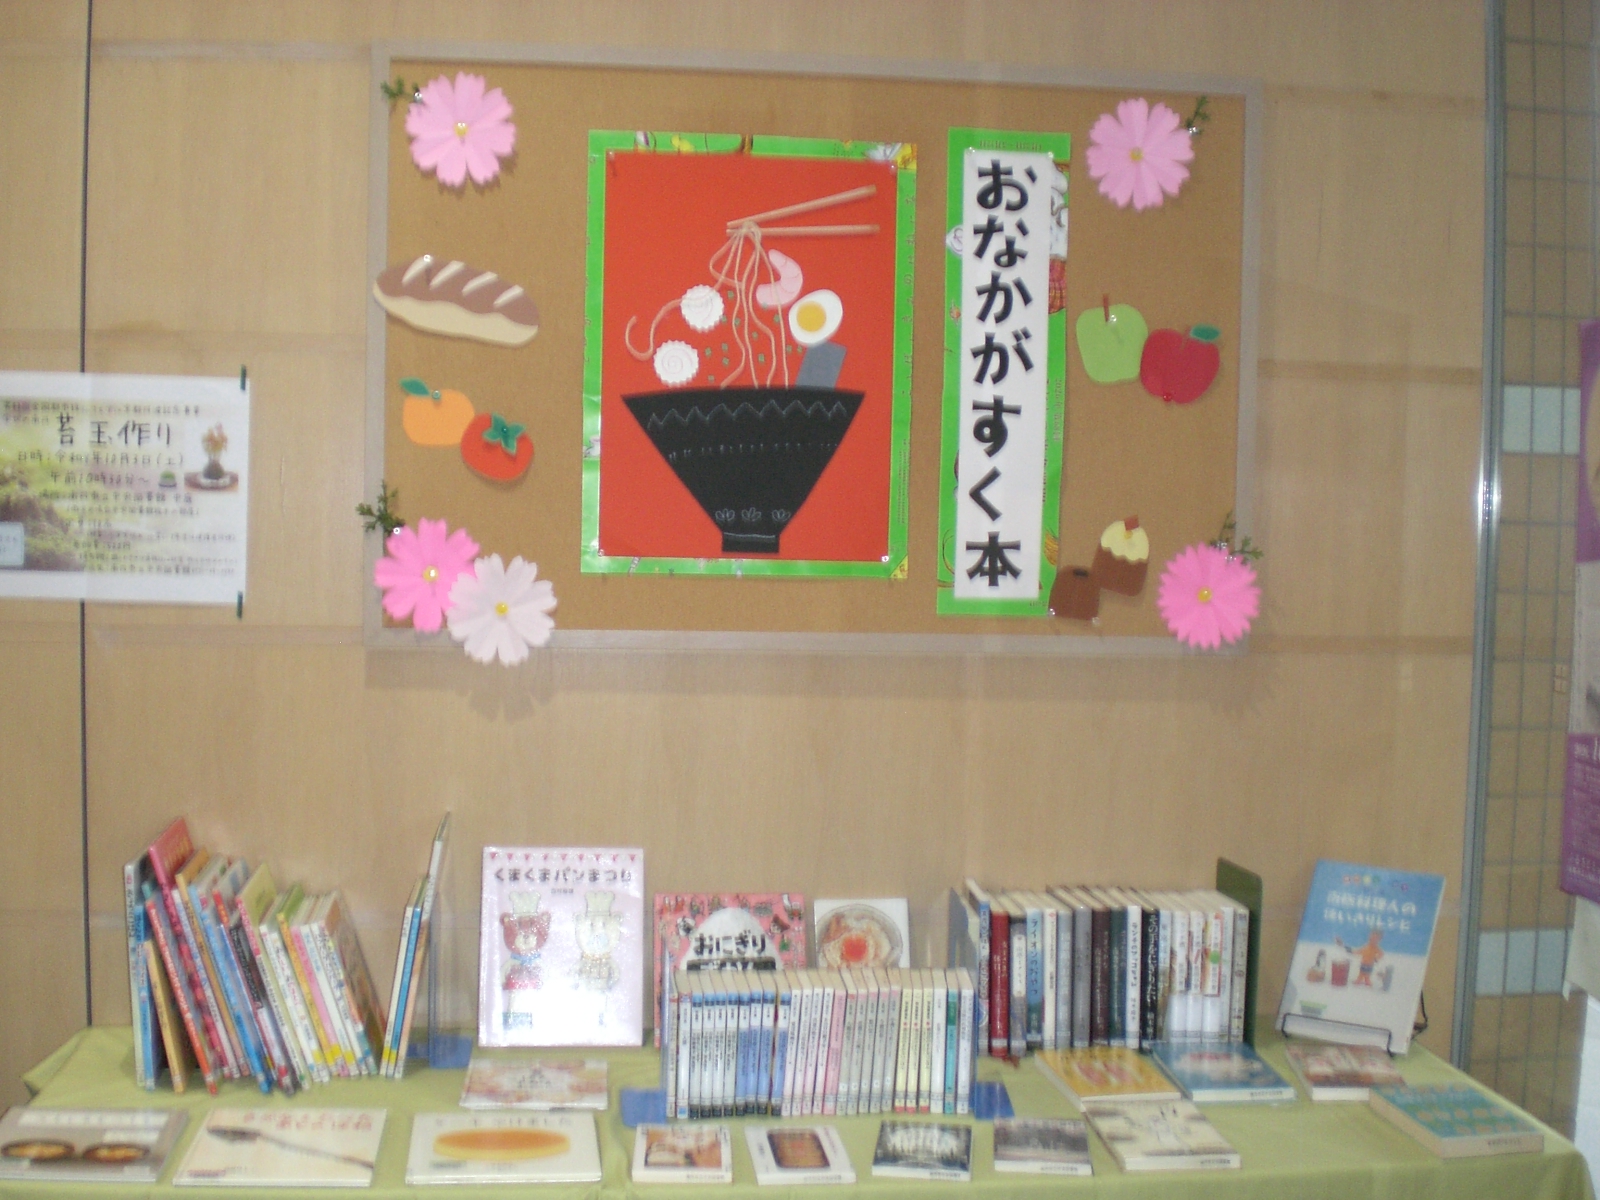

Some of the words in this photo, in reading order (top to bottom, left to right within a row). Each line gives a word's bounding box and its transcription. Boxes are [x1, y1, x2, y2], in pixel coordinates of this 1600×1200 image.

[56, 412, 170, 446] 苔玉作り
[965, 158, 1039, 588] おなかがすく本
